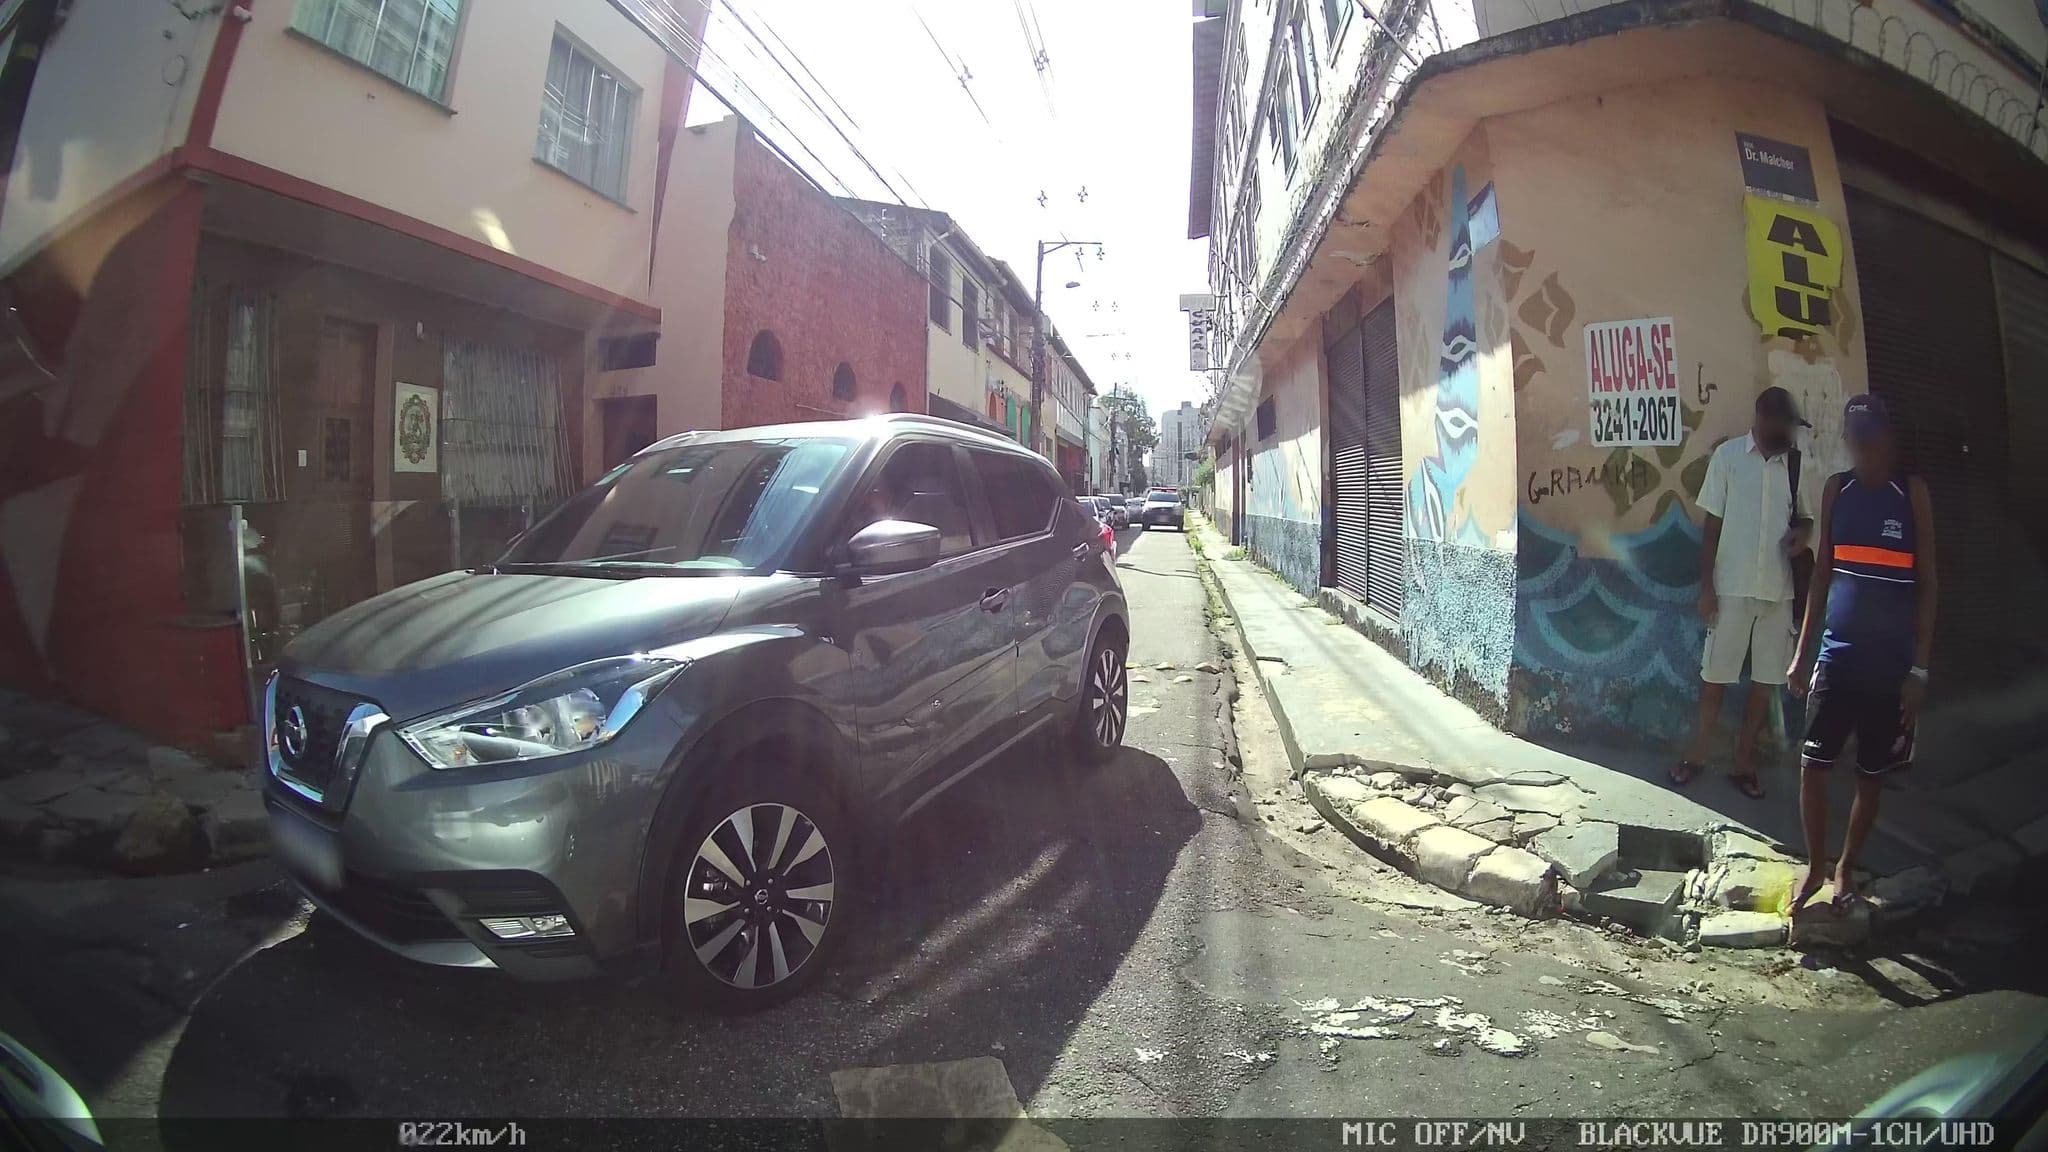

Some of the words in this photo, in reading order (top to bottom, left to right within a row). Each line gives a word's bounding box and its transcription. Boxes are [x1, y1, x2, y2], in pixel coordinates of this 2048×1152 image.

[1745, 147, 1759, 162] Dr.
[1760, 151, 1794, 171] Malcher
[1590, 323, 1676, 393] ALUGA-SE
[1592, 396, 1677, 442] 3241-2067
